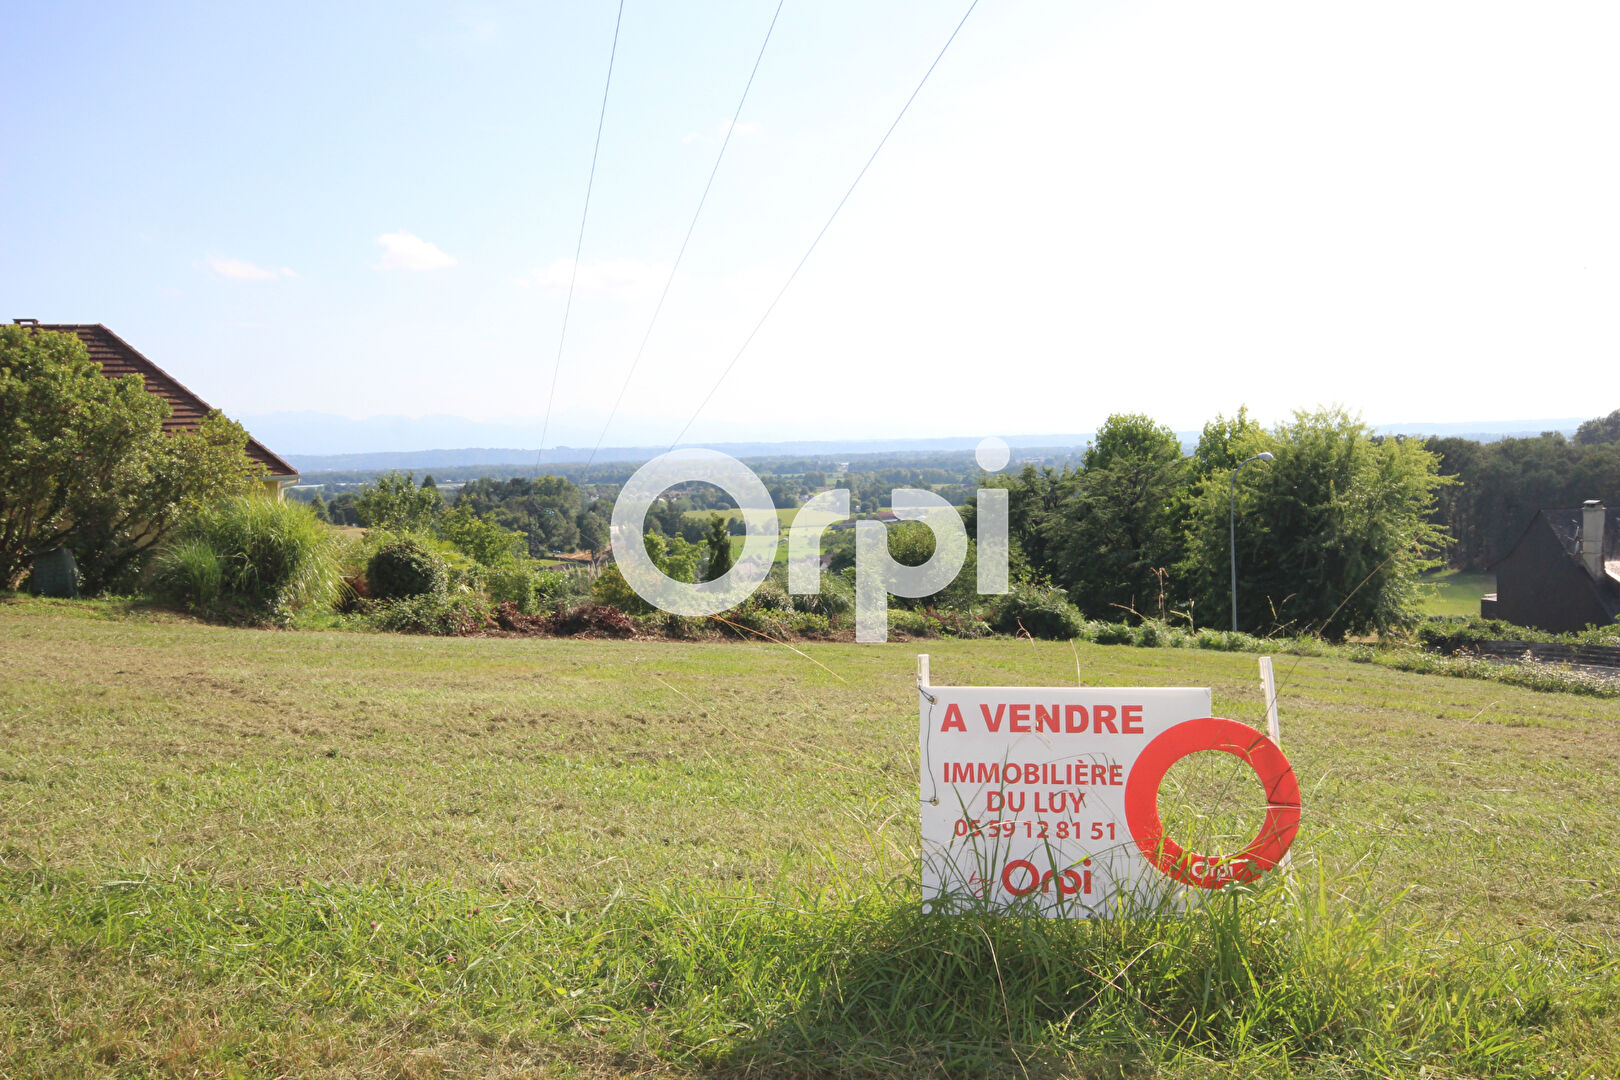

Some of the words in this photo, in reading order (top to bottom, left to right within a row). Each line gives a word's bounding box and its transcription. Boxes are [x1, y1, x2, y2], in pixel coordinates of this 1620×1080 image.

[940, 703, 967, 732] A
[979, 703, 1144, 734] VENDRE
[943, 759, 1123, 786] IMMOBILIÈRE
[986, 791, 1025, 812] DU
[1034, 792, 1086, 813] LUY
[954, 819, 981, 837] 05
[988, 820, 1016, 838] 59
[1023, 821, 1049, 839] 12
[1056, 821, 1080, 839] 81
[1090, 822, 1116, 840] 51
